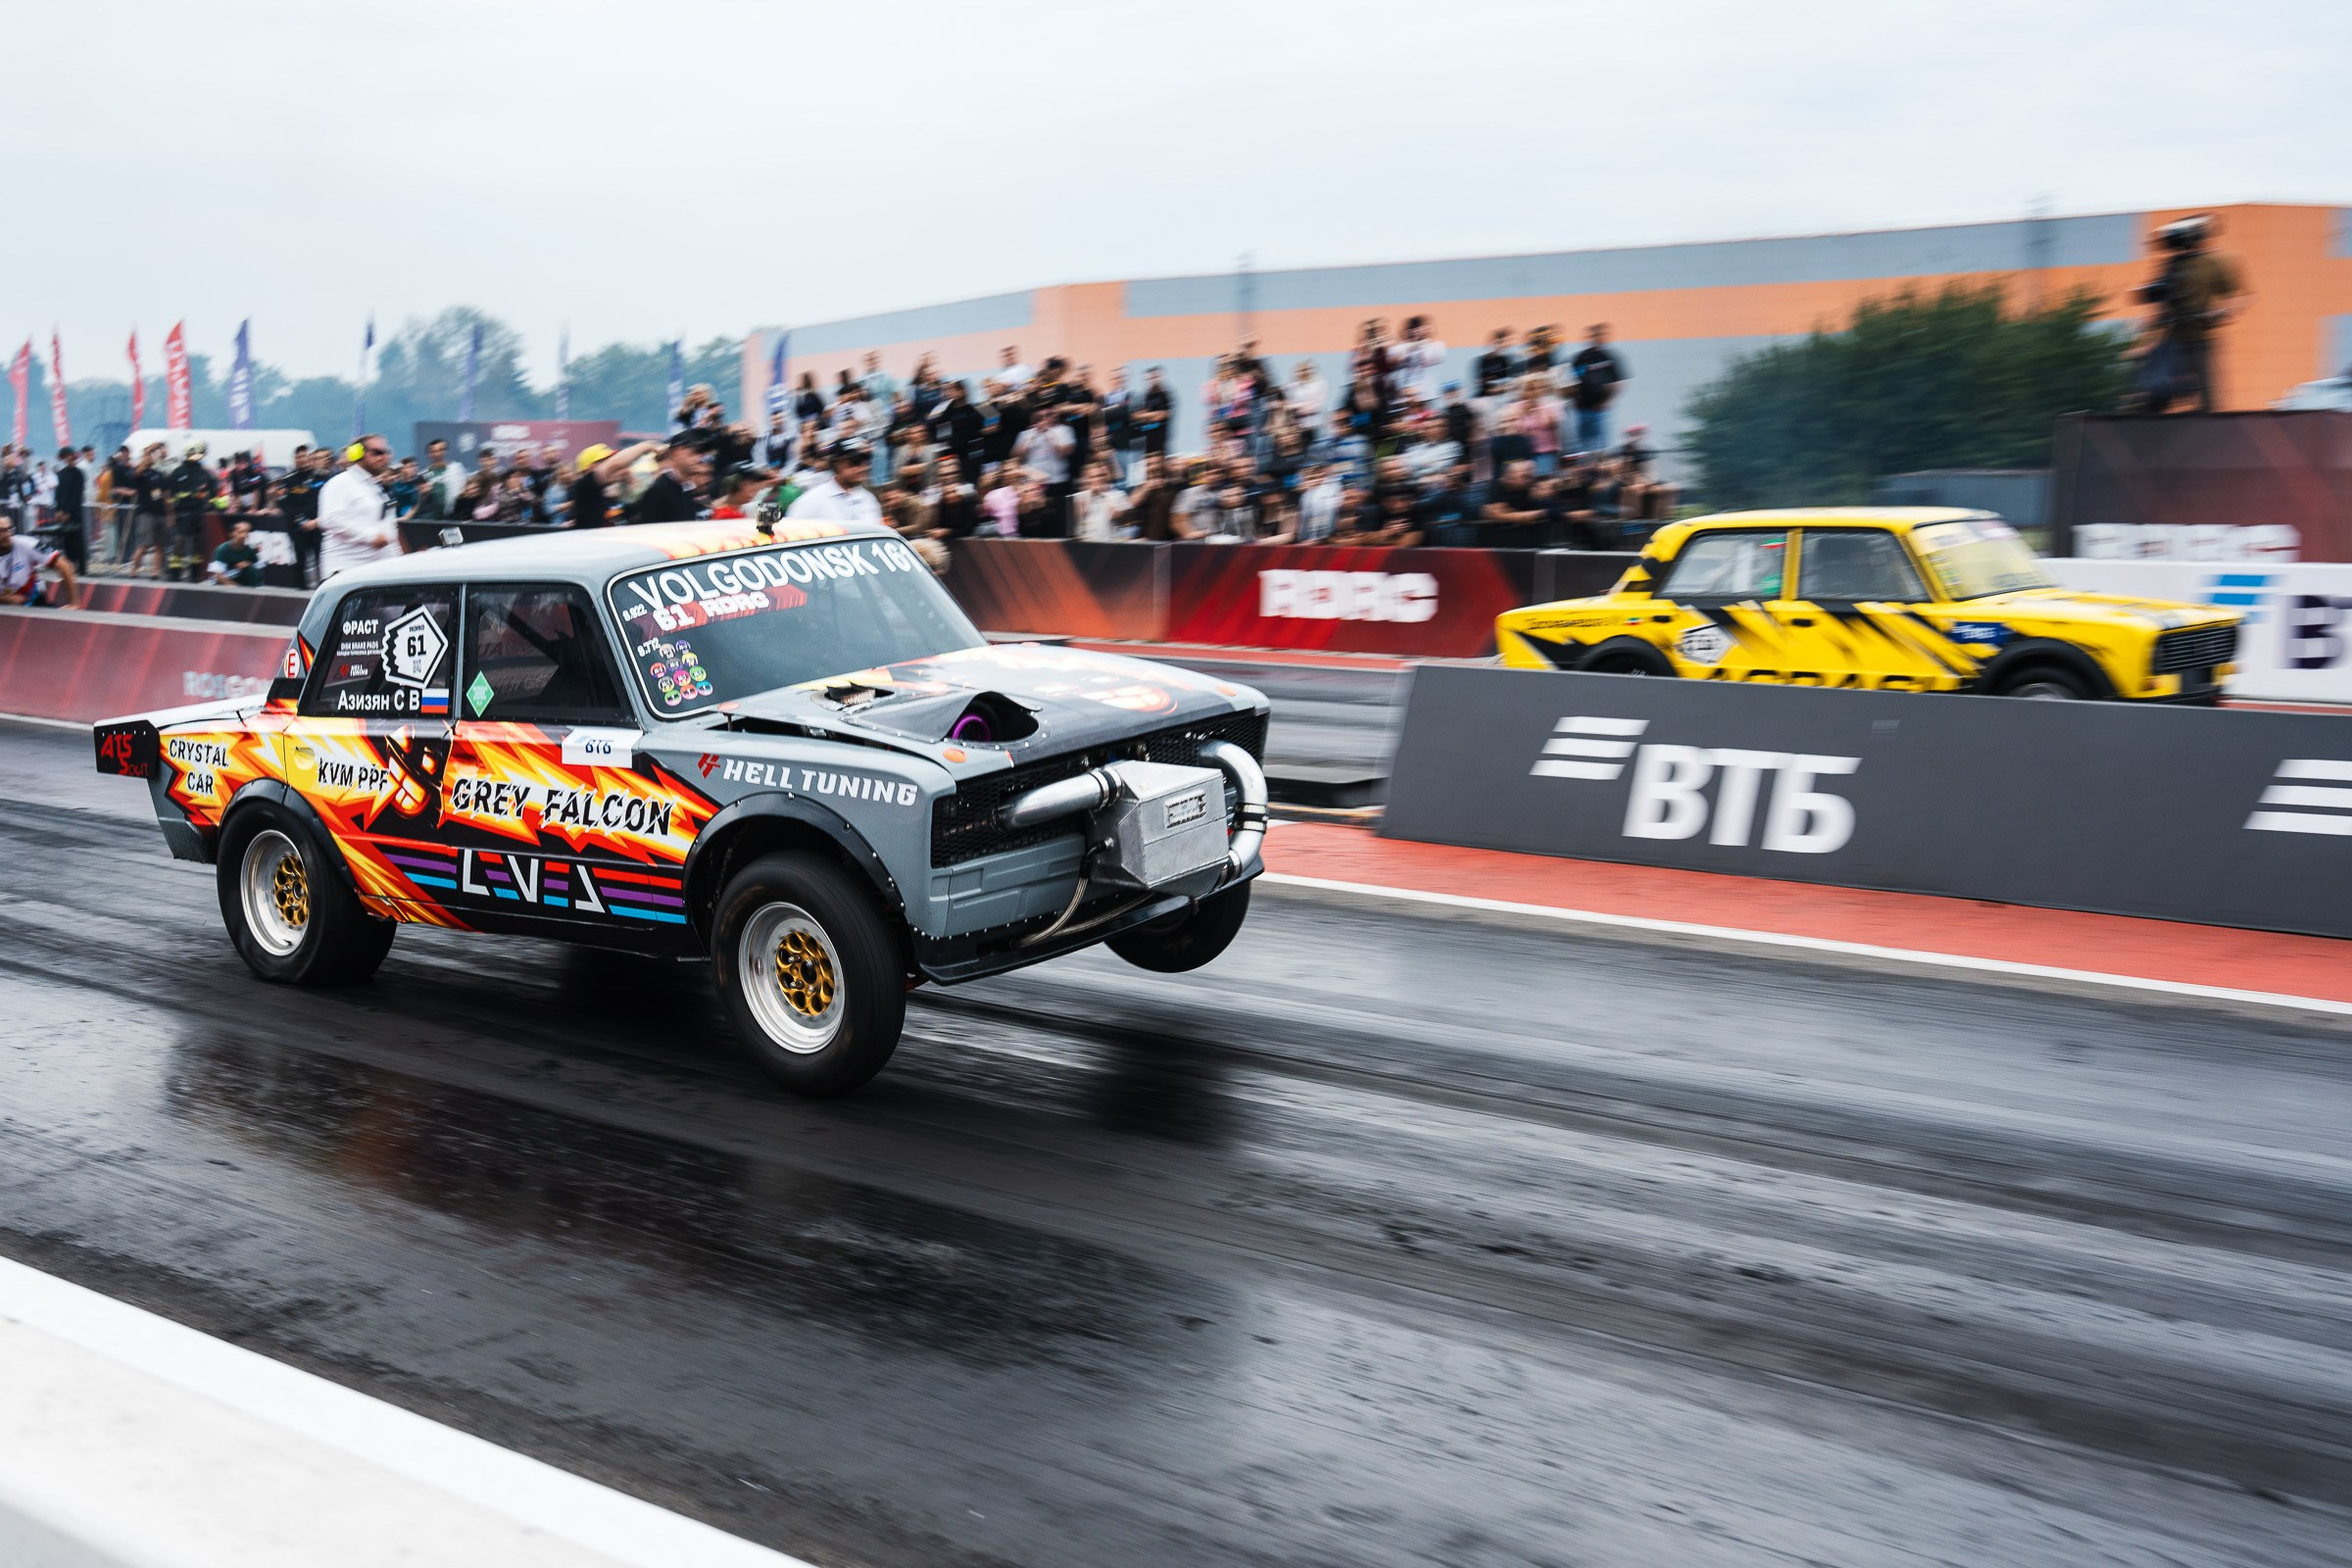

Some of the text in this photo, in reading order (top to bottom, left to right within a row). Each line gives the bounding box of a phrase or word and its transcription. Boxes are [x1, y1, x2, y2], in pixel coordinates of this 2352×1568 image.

[627, 541, 923, 612] VOLGODONSK 161
[342, 619, 379, 635] ФРАСТ
[653, 608, 695, 631] 61
[352, 641, 366, 650] BRAKE
[407, 634, 427, 658] 61
[337, 689, 419, 710] Азизян С В
[169, 739, 229, 767] CRYSTAL
[186, 771, 215, 795] CAR
[318, 759, 389, 792] KVM PPF
[723, 759, 918, 807] HELL TUNING
[452, 777, 673, 837] GREY FALCON
[1621, 743, 1863, 854] ВТБ
